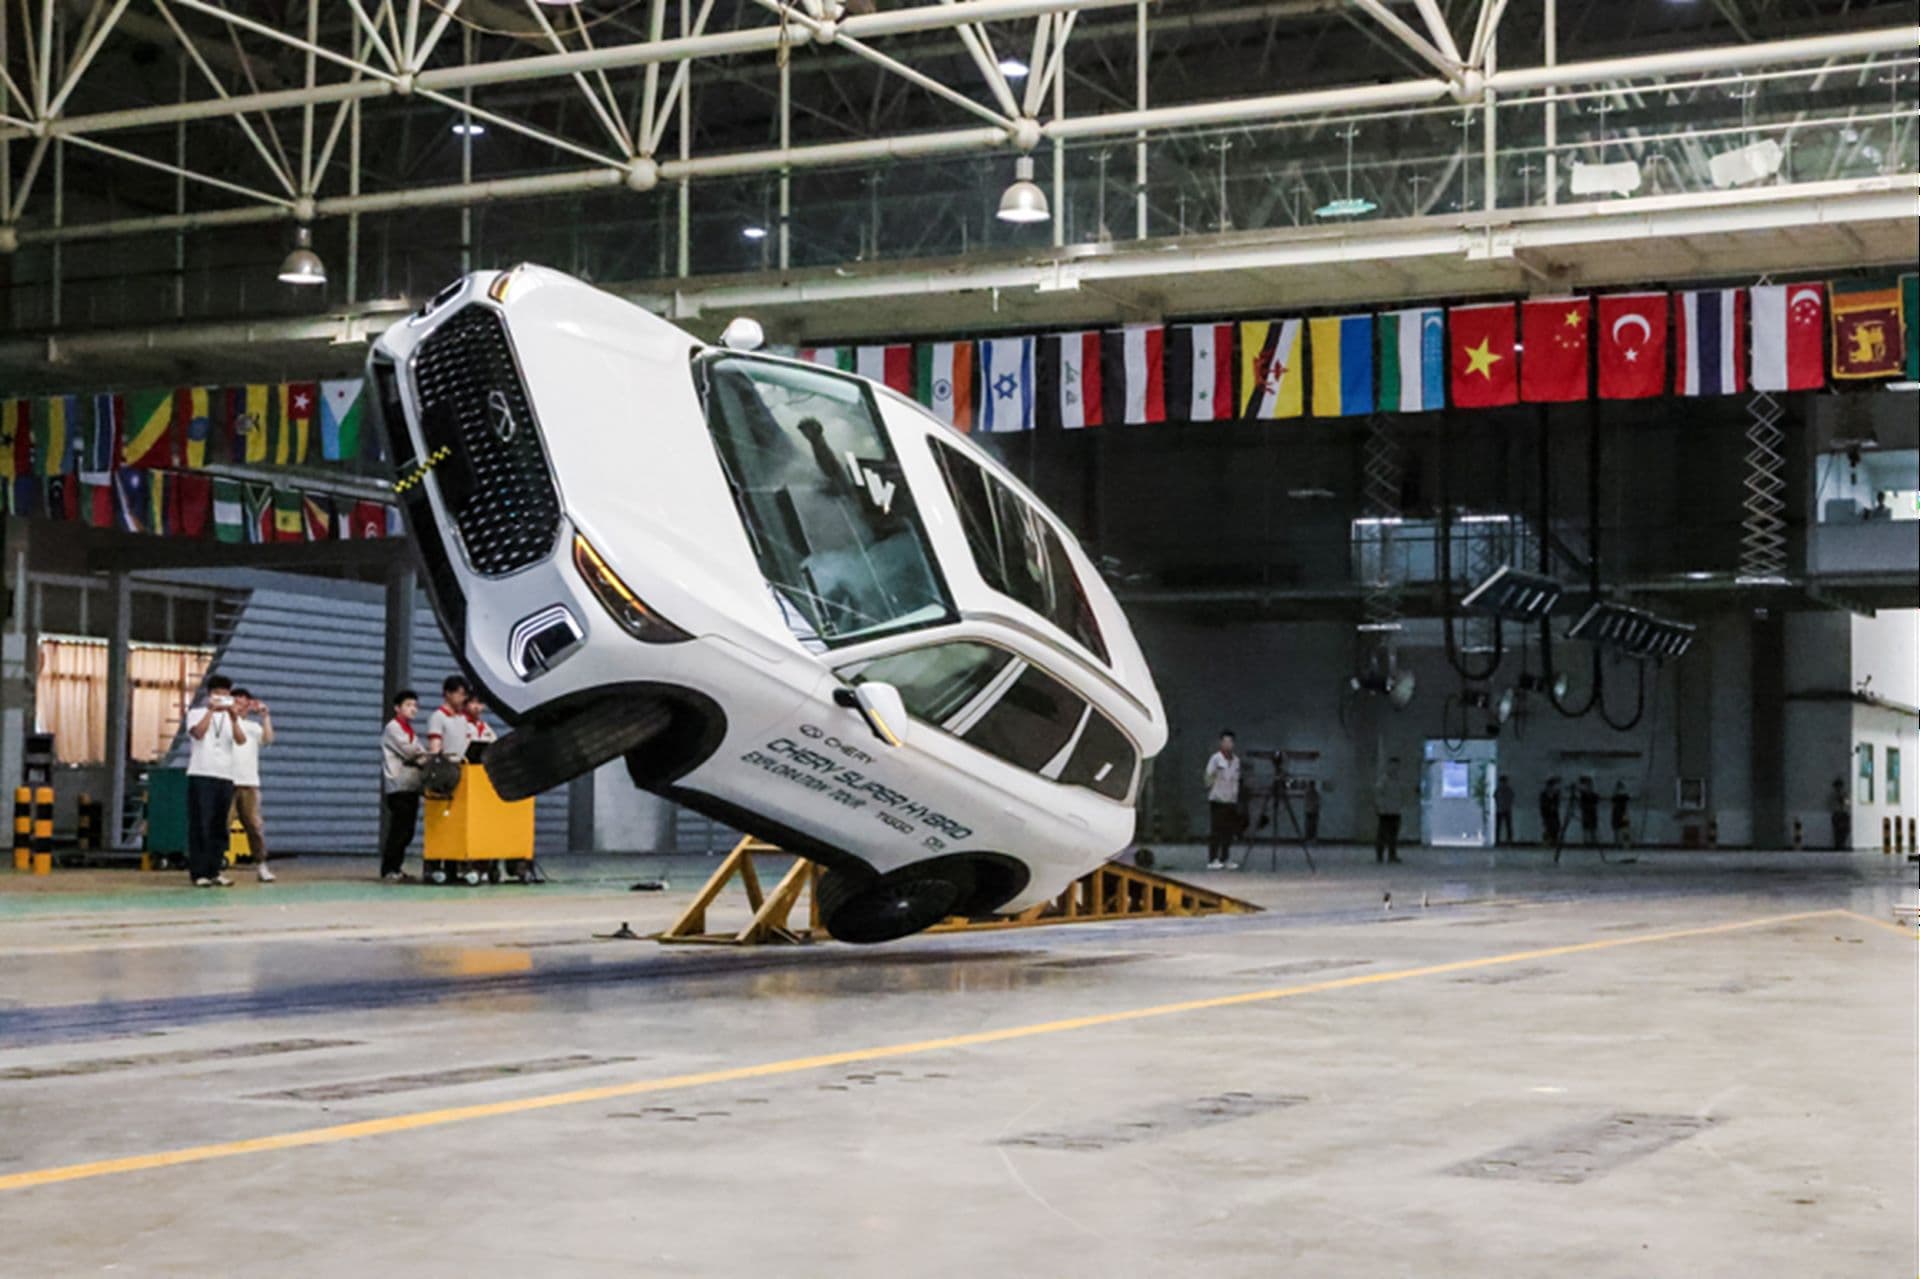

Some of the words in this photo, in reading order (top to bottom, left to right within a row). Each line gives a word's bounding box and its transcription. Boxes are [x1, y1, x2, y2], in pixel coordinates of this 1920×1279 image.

[823, 736, 875, 764] CHERY
[740, 751, 832, 792] EXPLORATION
[766, 738, 845, 774] CHERY
[833, 770, 909, 807] SUPER
[899, 802, 973, 840] HYBRID
